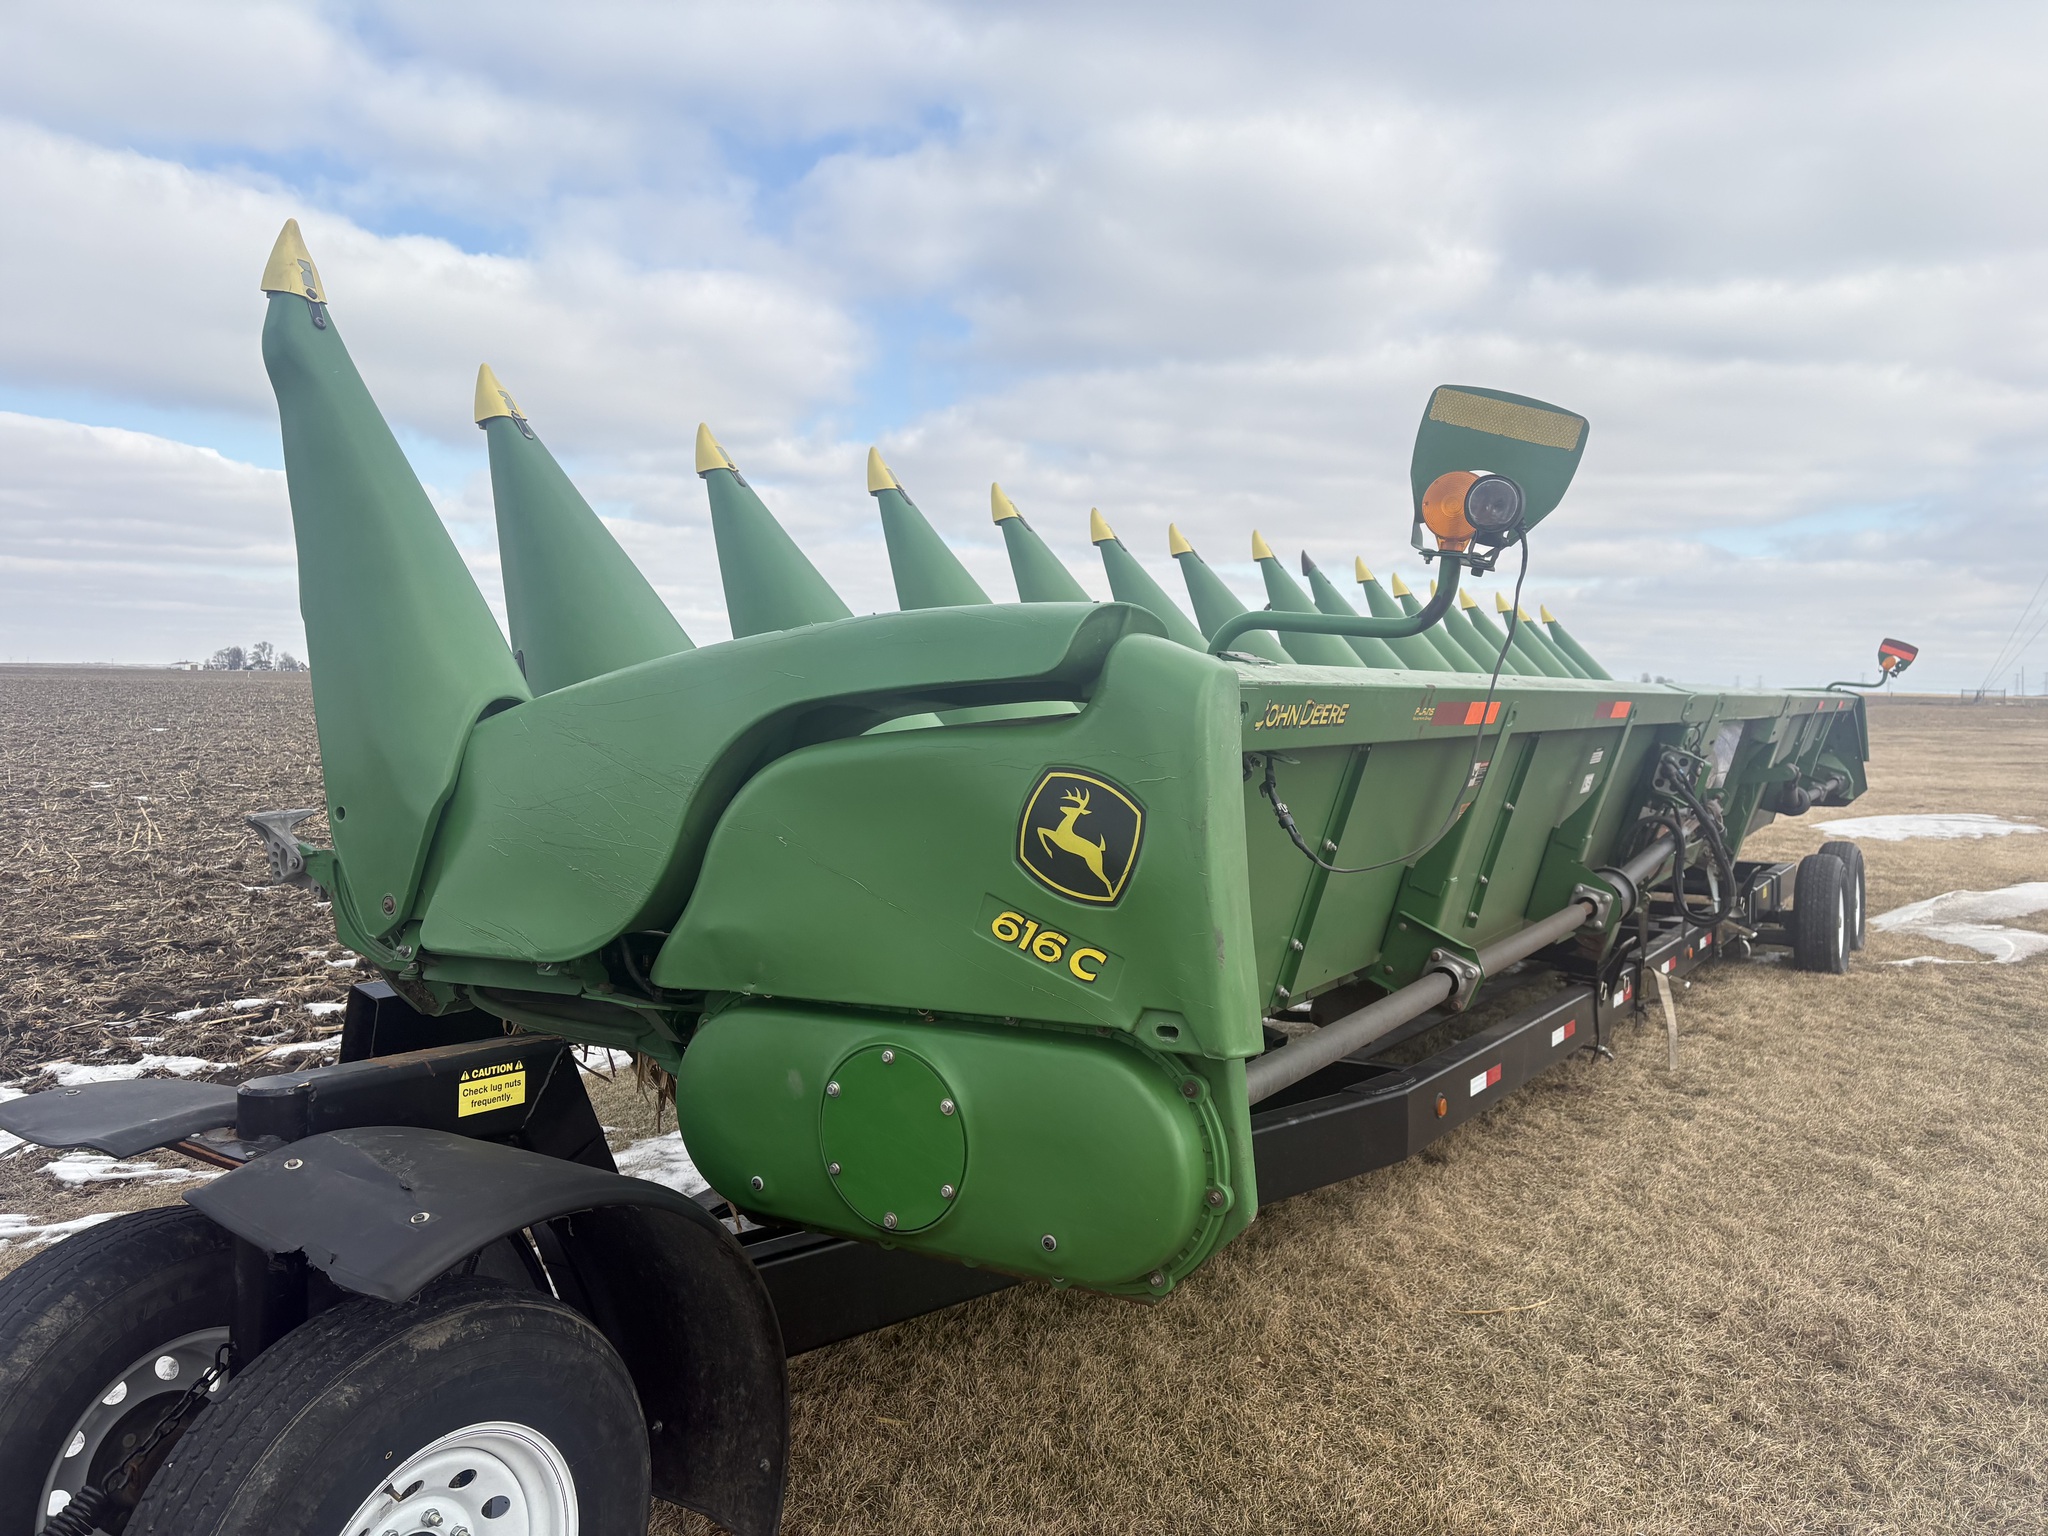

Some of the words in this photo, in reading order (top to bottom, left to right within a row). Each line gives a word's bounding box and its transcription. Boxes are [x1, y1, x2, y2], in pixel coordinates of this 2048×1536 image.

[1254, 699, 1303, 731] JOHN
[1299, 699, 1350, 728] DEERE
[471, 1063, 513, 1078] CAUTION
[462, 1085, 488, 1097] Check
[504, 1079, 521, 1088] nuts
[471, 1093, 513, 1107] frequently.
